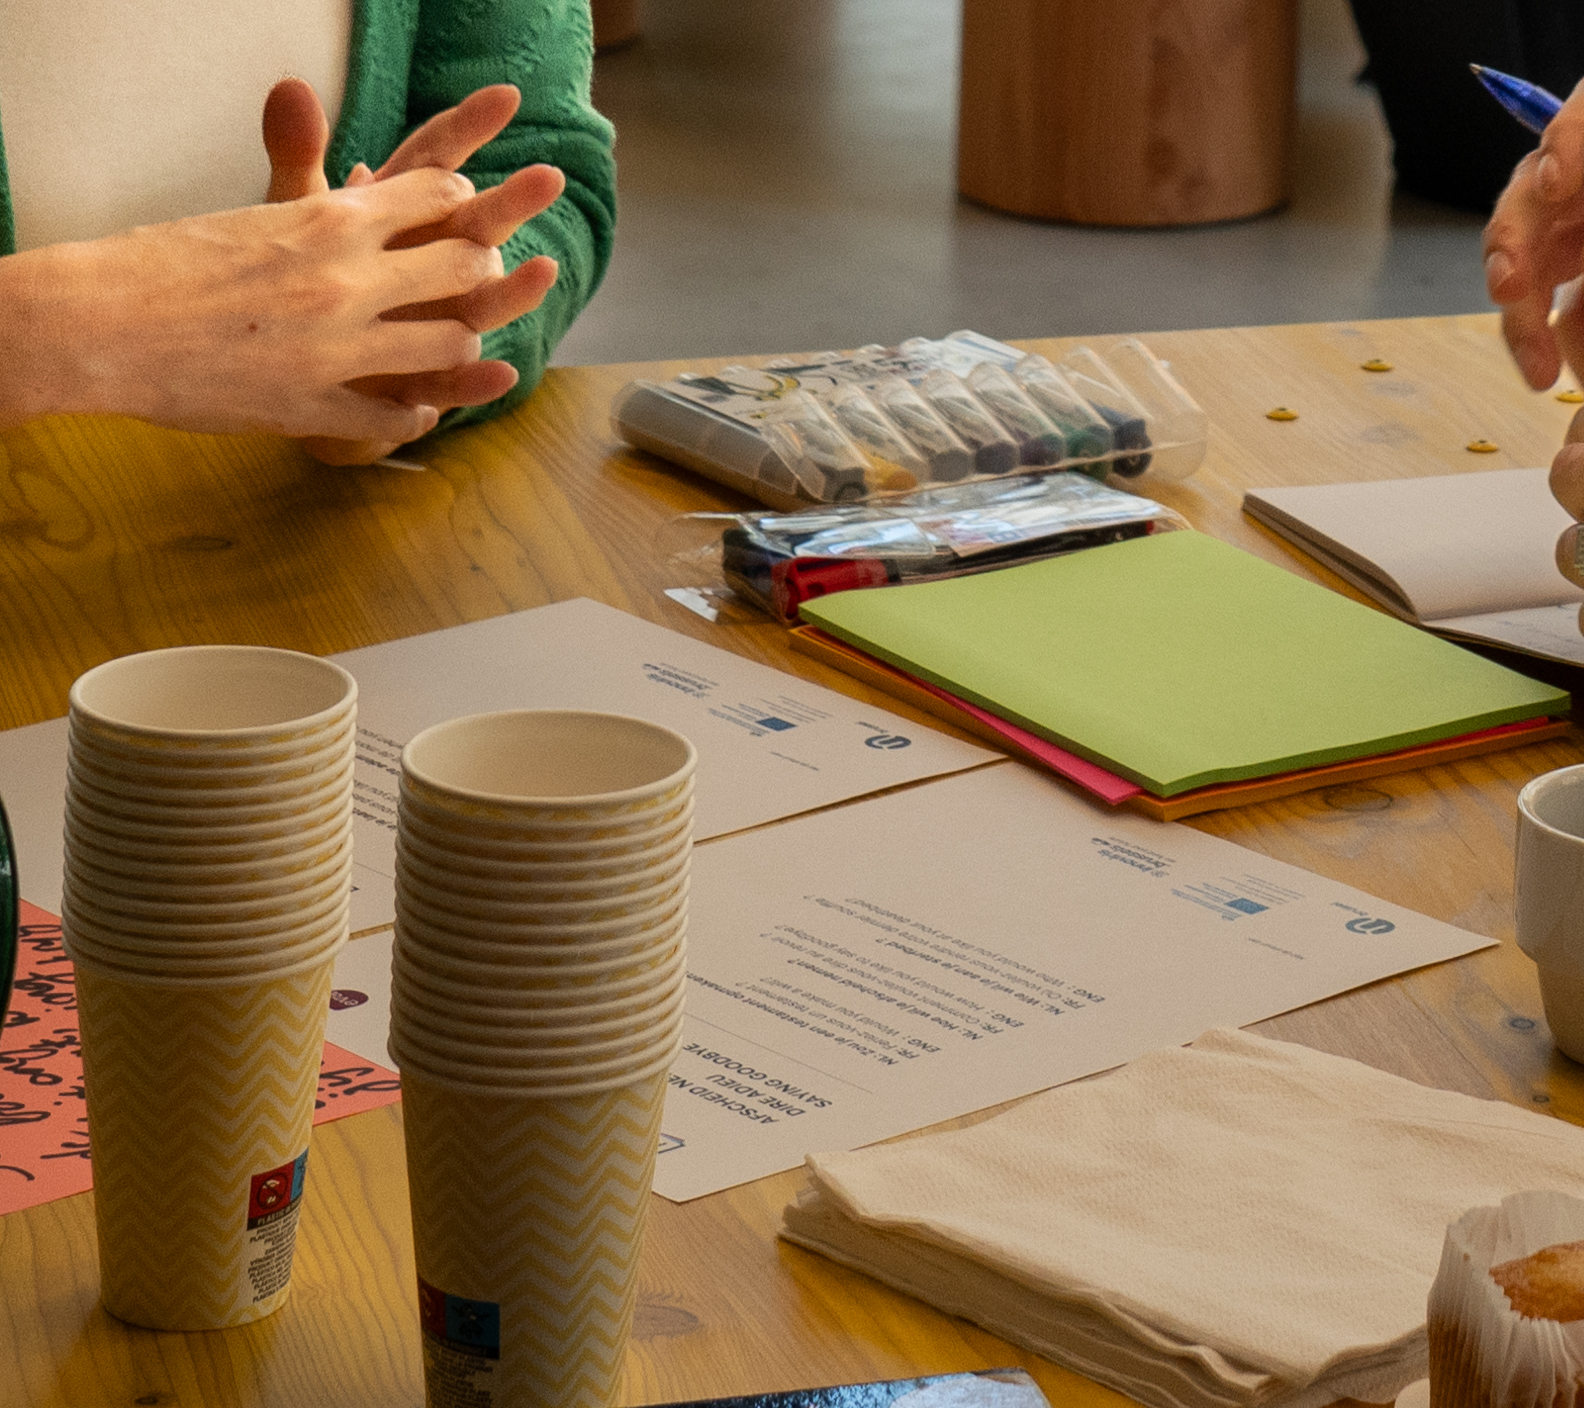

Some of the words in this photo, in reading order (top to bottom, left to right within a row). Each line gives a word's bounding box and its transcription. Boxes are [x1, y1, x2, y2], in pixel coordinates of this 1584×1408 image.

[834, 946, 856, 957] say
[885, 941, 942, 964] sterfbed
[975, 948, 998, 958] you
[787, 959, 842, 981] nemen?
[870, 963, 893, 973] like
[996, 957, 1036, 974] would
[893, 971, 919, 981] you
[954, 966, 981, 979] aan
[847, 968, 918, 997] voulez-vous
[991, 983, 1014, 994] wil
[838, 979, 897, 1003] afscheid
[914, 981, 954, 998] would
[746, 985, 809, 1012] testament
[801, 993, 836, 1008] make
[956, 997, 984, 1011] How
[1014, 993, 1040, 1006] Wie
[835, 1007, 863, 1018] you
[896, 1002, 916, 1010] je
[907, 1007, 931, 1018] wil
[917, 996, 980, 1024] Comment
[1041, 1004, 1065, 1015] NL:
[742, 998, 809, 1028] testament
[857, 1017, 900, 1036] Would
[930, 1017, 959, 1030] Hoe
[980, 1023, 1004, 1034] FR:
[809, 1026, 835, 1038] een
[958, 1028, 983, 1040] NL:
[834, 1037, 853, 1045] je
[847, 1042, 875, 1056] Zou
[896, 1048, 920, 1059] FR:
[682, 1043, 768, 1080] GOODBYE
[874, 1054, 899, 1066] NL:
[706, 1074, 766, 1098] ADIEU
[764, 1079, 833, 1108] SAYING
[688, 1086, 779, 1124] AFSCHEID
[758, 1096, 806, 1117] DIRE
